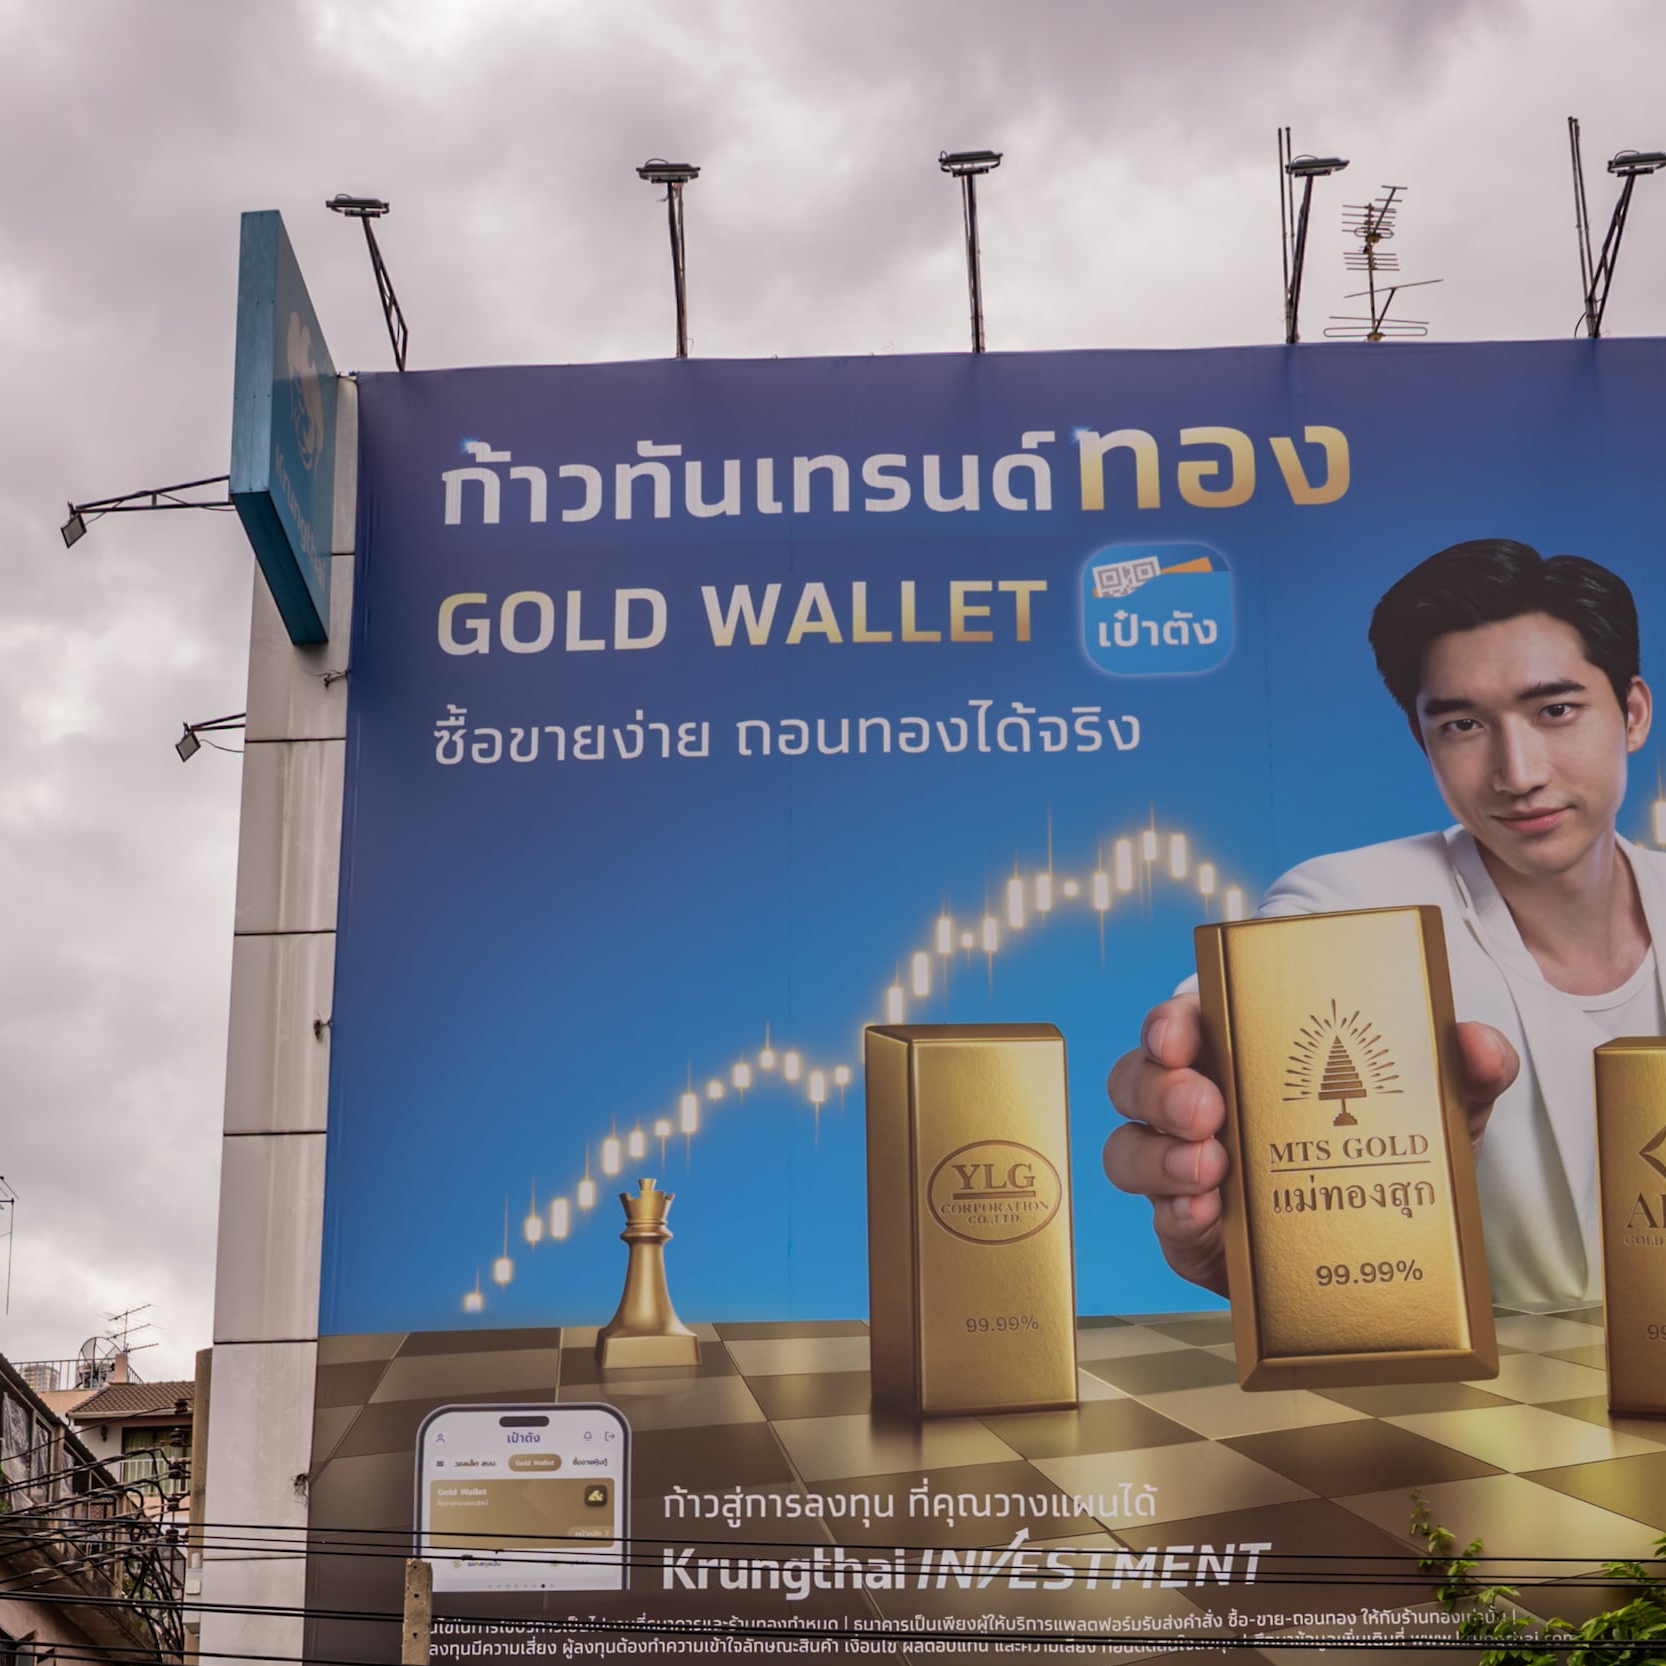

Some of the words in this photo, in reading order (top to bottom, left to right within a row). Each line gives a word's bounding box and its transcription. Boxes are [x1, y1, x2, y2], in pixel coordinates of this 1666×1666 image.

[437, 587, 667, 655] GOLD
[702, 580, 1048, 646] WALLET
[1099, 607, 1219, 649] เป๋าตัง
[434, 704, 710, 766] ซื้อขายง่าย
[737, 699, 1142, 760] ถอนทองได้จริง
[1270, 1140, 1331, 1164] MTS
[1342, 1134, 1429, 1159] GOLD
[951, 1163, 1036, 1191] YLG
[940, 1200, 1049, 1214] CORPORATION
[1272, 1175, 1436, 1218] แม่ทองสุก
[1624, 1235, 1664, 1247] GOLD
[1315, 1259, 1423, 1286] 99.99%
[966, 1315, 1039, 1333] 99.99%
[437, 1488, 458, 1497] Gold
[460, 1487, 487, 1497] Wallet
[664, 1485, 894, 1530] ก้าวสู่การลงทุน
[908, 1480, 1157, 1523] ที่คุณวางแผนได้
[662, 1545, 906, 1597] Krungthai
[917, 1532, 1272, 1590] INVESTMENT
[1229, 1608, 1356, 1627] ซื้อ-ขาย-ถอนทอง
